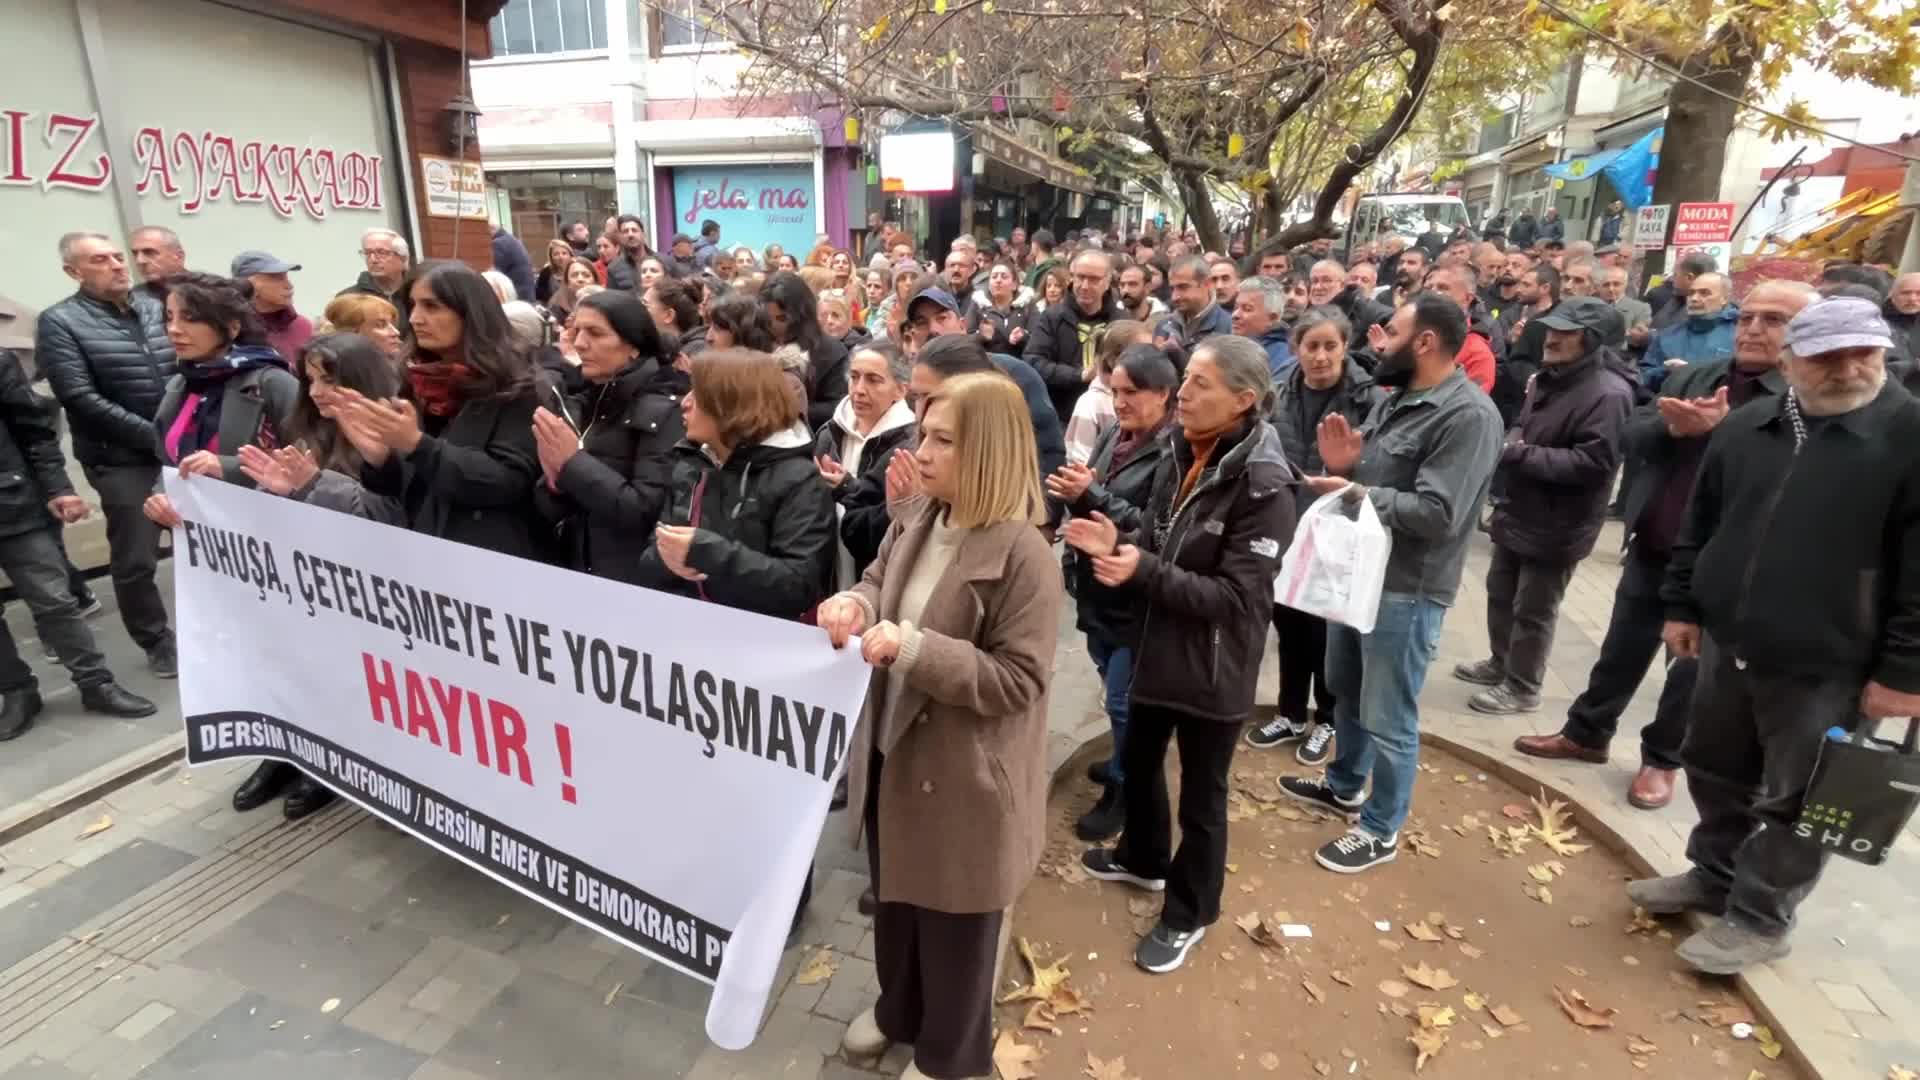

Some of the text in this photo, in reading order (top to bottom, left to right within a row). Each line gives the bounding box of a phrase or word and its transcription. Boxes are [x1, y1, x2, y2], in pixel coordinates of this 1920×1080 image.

[136, 127, 384, 217] AYAKKABI
[685, 177, 809, 224] jela ma
[1682, 207, 1729, 220] MODA
[183, 519, 847, 783] FUHUŞA, ÇETELEŞMEYE VE YOZLAŞMAYA
[361, 651, 577, 805] HAYIR !
[199, 717, 286, 752] DERSİM
[286, 731, 327, 772] KADIN
[328, 750, 412, 815] PLATFORMU
[424, 797, 486, 854] DERSİM
[490, 830, 541, 882] EMEK
[544, 855, 570, 896] VE
[575, 870, 698, 959] DEMOKRASİ
